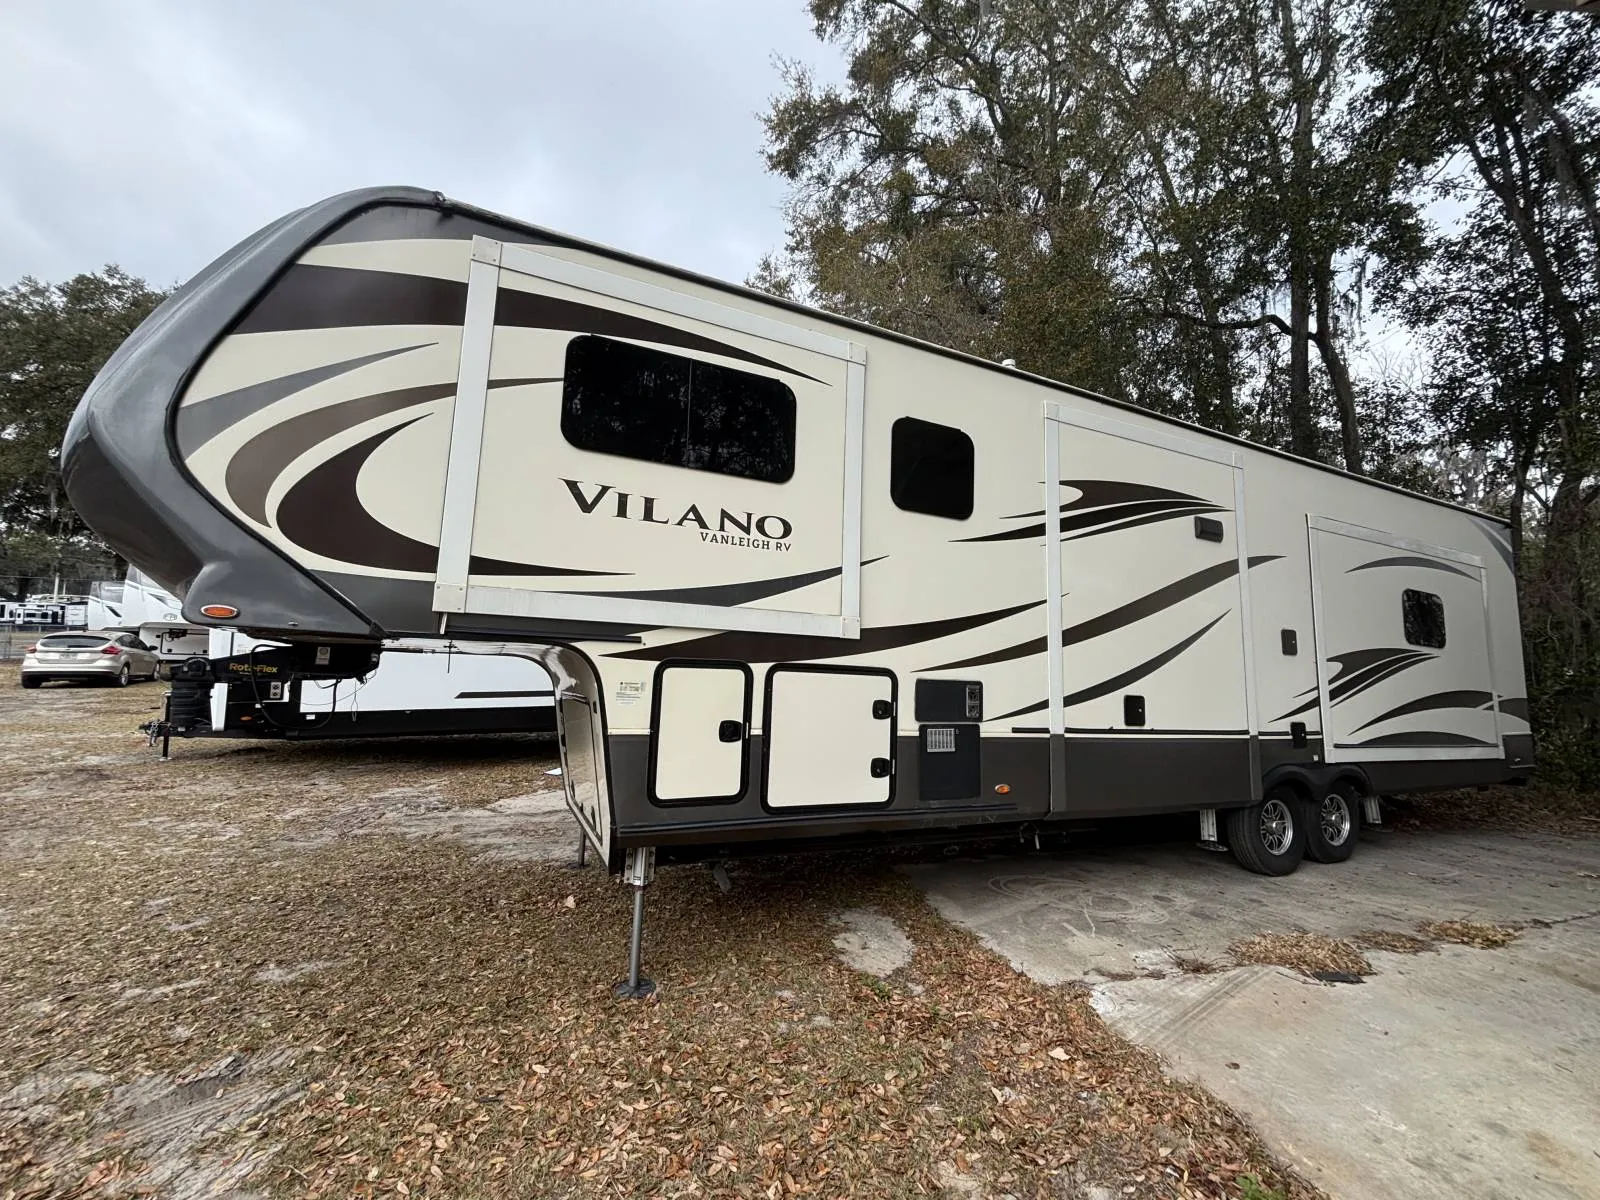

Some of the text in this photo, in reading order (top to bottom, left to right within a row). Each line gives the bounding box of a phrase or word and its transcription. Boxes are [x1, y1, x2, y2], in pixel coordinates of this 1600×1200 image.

[557, 477, 792, 540] VILANO
[700, 532, 791, 552] VANLEIGH RV
